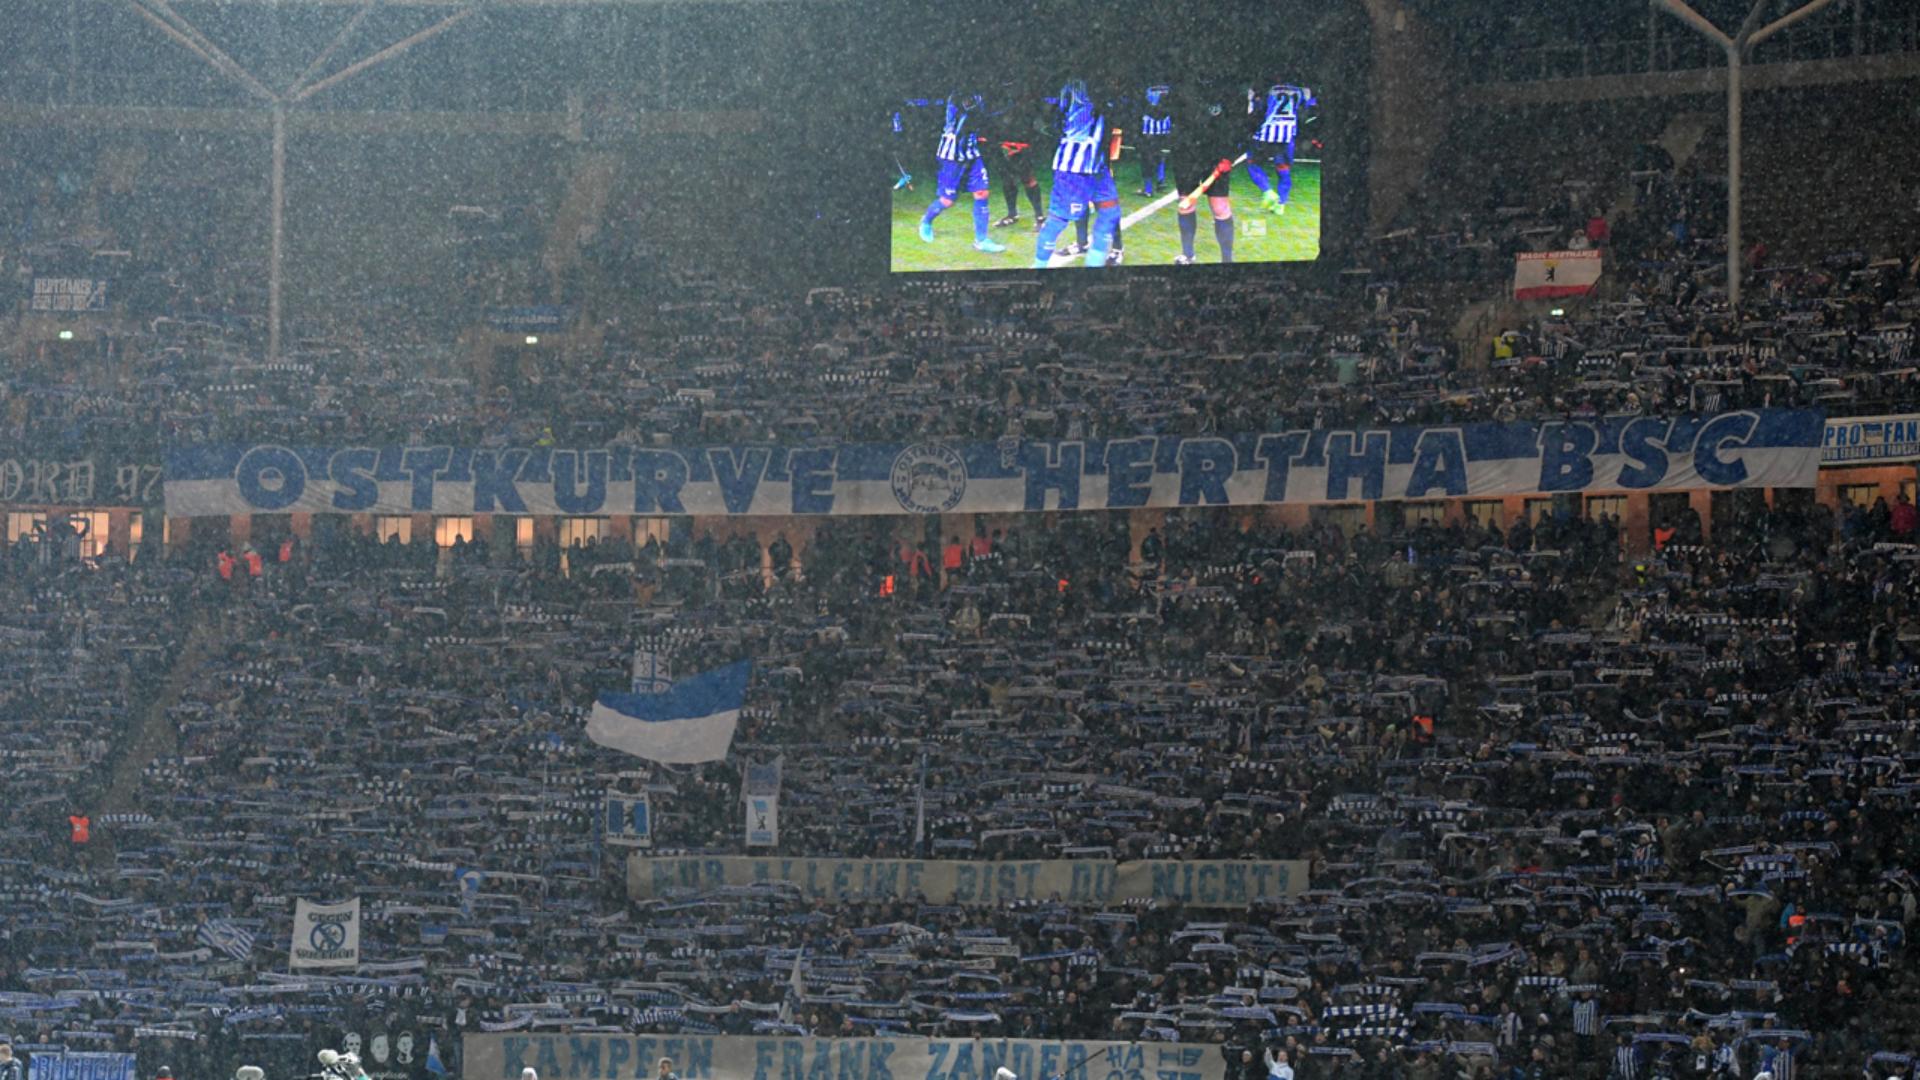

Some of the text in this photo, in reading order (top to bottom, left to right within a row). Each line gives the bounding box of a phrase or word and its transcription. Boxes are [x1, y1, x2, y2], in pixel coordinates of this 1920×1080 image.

[1824, 421, 1917, 446] PRO FAN
[234, 410, 1761, 515] OSTKURVE HERTHA BSC
[115, 463, 161, 501] 97
[754, 1041, 895, 1080] FRANK
[927, 1043, 1088, 1080] ZANDER
